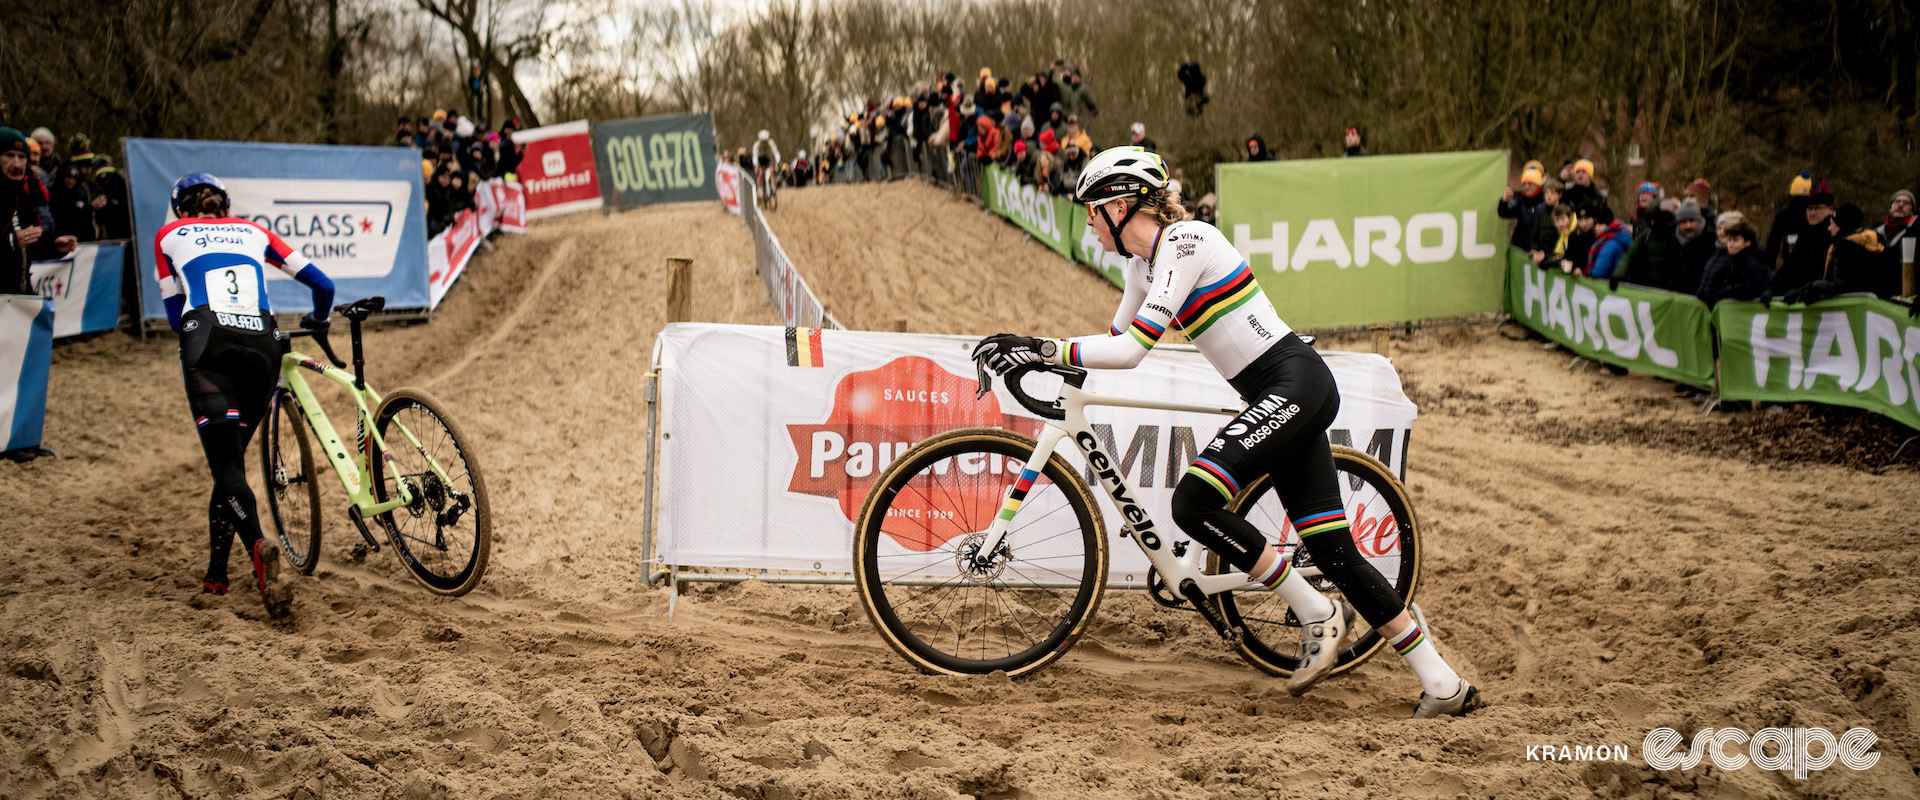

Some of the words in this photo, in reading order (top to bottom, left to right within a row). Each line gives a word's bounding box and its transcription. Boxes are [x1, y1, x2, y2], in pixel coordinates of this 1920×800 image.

[606, 130, 705, 194] GOLAZO
[525, 169, 591, 195] Trimetal
[1085, 166, 1112, 187] GIRO
[992, 169, 1061, 244] HAROL
[193, 225, 253, 234] baloise
[1181, 233, 1204, 242] VISMA
[195, 234, 244, 248] glowi
[301, 242, 357, 259] CLINIC
[1176, 243, 1196, 252] lease
[1233, 210, 1497, 274] HAROL
[225, 269, 239, 295] 3
[1166, 270, 1173, 288] 1
[1146, 302, 1173, 319] SRAM
[1523, 263, 1679, 369] HAROL
[216, 312, 264, 332] GOLAZO
[1249, 318, 1274, 341] BETCITY
[883, 388, 950, 405] SAUCES
[1240, 393, 1288, 425] VISMA
[1238, 424, 1272, 450] lease
[1076, 430, 1162, 551] cervélo
[886, 508, 921, 519] SINCE
[926, 511, 954, 519] 1909
